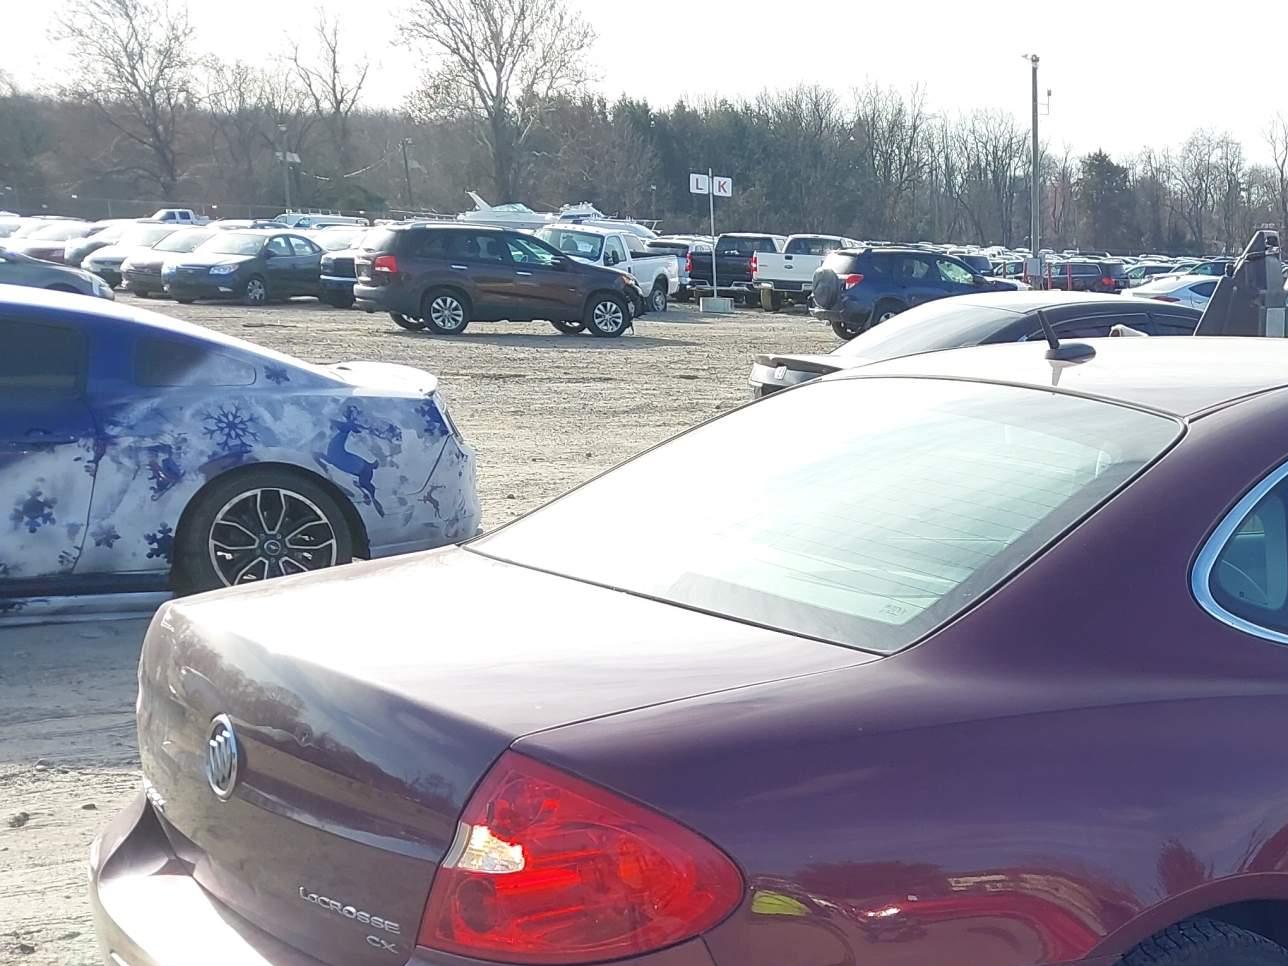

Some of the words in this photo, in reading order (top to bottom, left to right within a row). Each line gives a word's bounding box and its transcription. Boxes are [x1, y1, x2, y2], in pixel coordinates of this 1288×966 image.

[695, 178, 705, 191] L
[718, 180, 727, 193] K
[366, 935, 399, 954] CX
